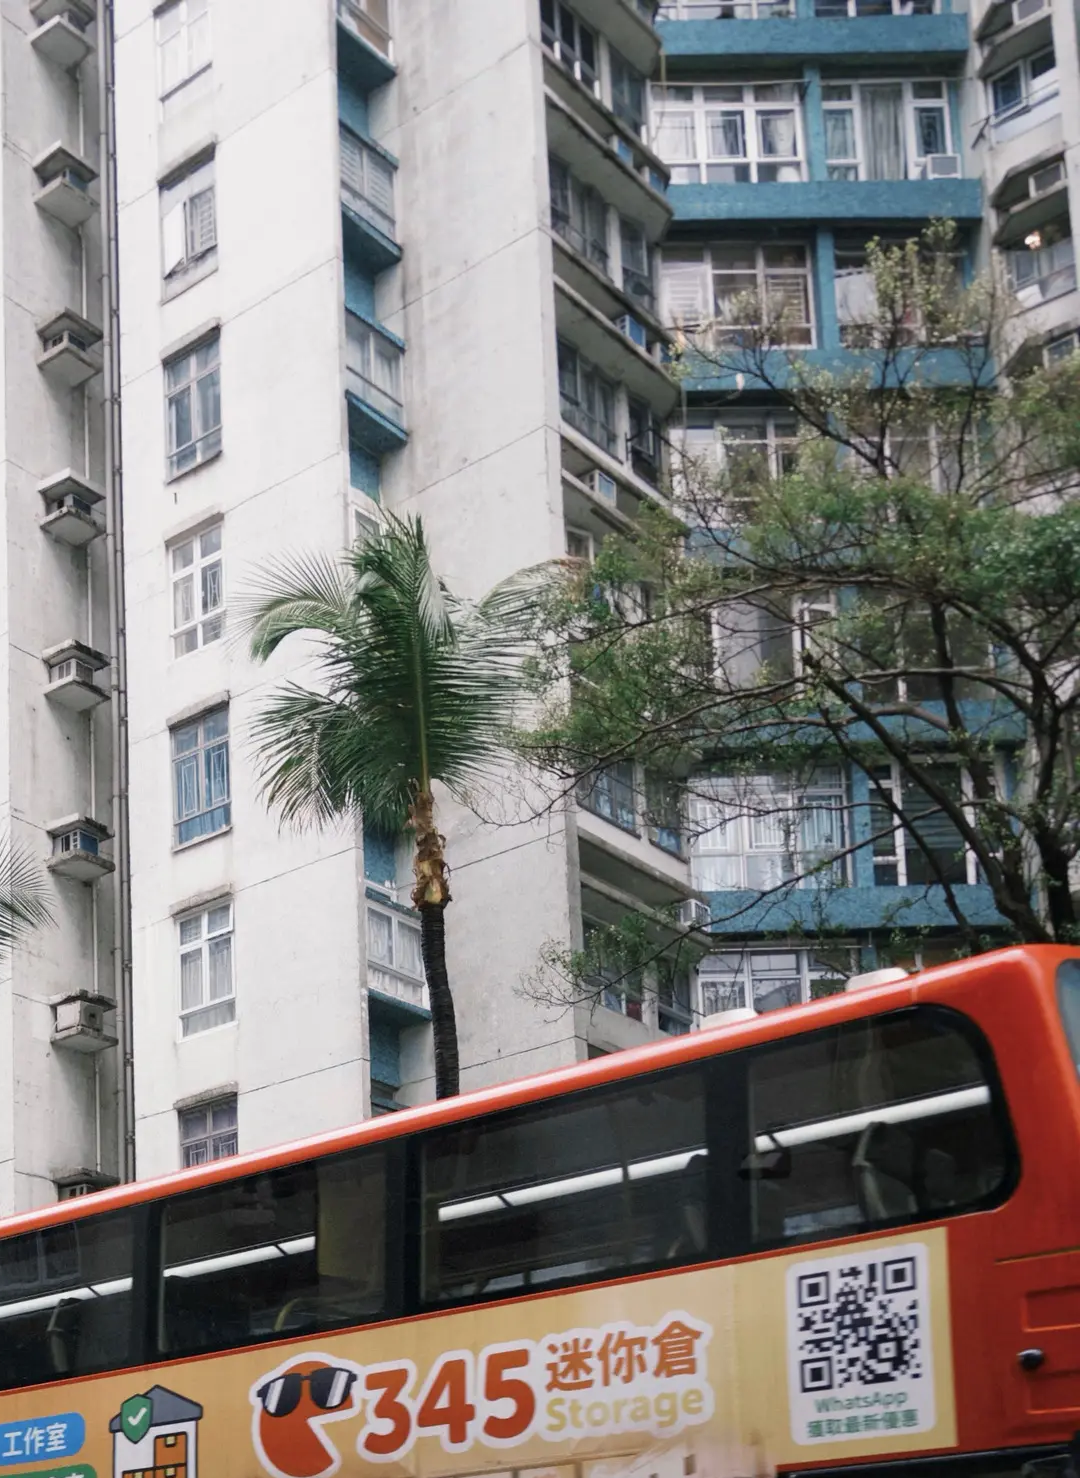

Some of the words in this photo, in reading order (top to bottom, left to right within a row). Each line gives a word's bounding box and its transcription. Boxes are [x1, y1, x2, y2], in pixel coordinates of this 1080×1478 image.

[544, 1320, 704, 1393] 迷你倉
[363, 1348, 537, 1455] 345
[545, 1388, 704, 1433] Storage
[814, 1391, 908, 1413] WhatsApp
[2, 1422, 68, 1458] 工作室
